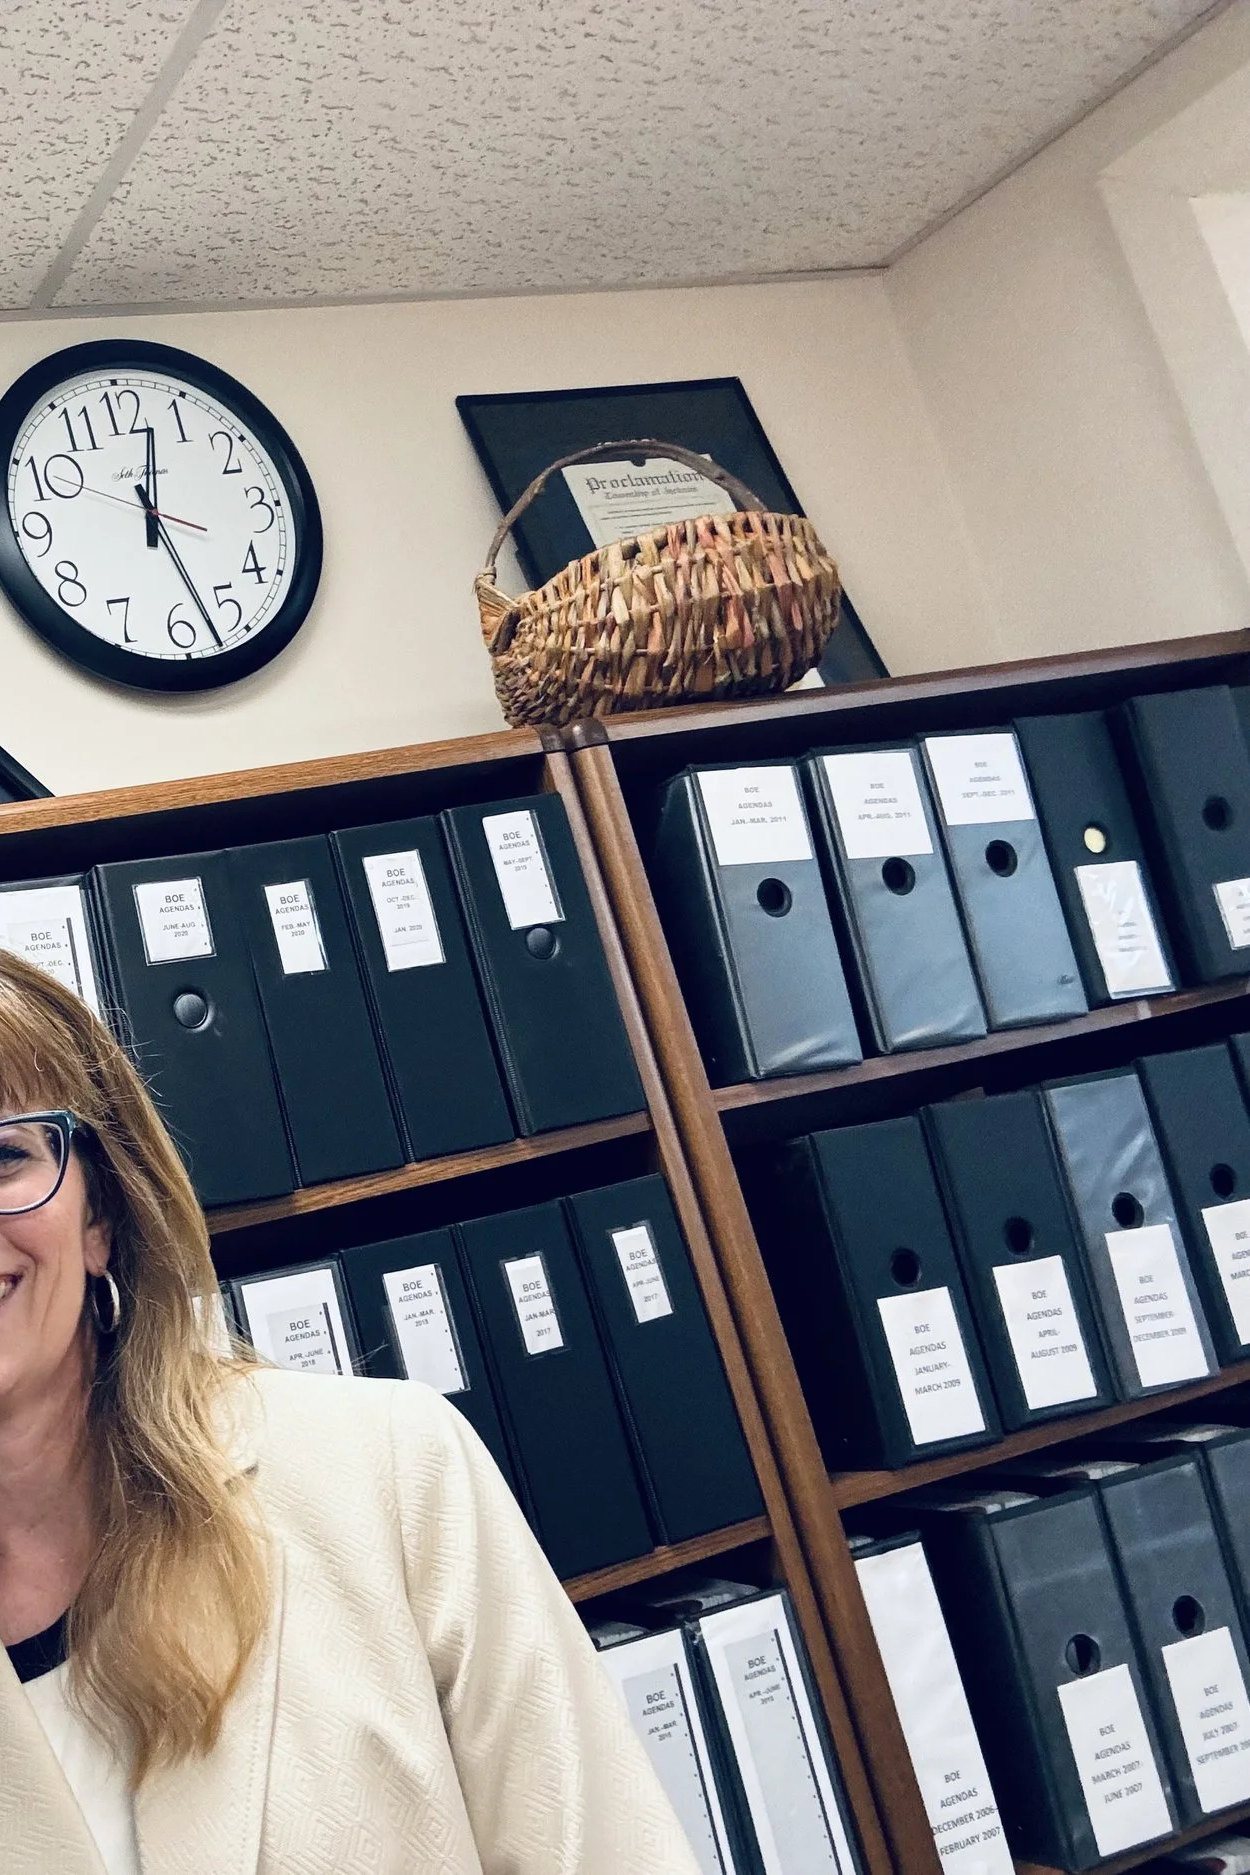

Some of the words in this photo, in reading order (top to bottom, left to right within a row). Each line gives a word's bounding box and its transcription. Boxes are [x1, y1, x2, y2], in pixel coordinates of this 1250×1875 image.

[99, 389, 150, 437] 12
[167, 398, 194, 443] 1
[58, 405, 104, 453] 11
[208, 431, 243, 475] 2
[24, 453, 85, 502] 10
[111, 467, 134, 482] Seth
[586, 471, 704, 494] Proclamation
[243, 486, 275, 533] 3
[21, 511, 53, 558] 9
[241, 539, 269, 585] 4
[54, 560, 87, 607] 8
[212, 582, 243, 632] 5
[106, 596, 138, 643] 7
[166, 603, 197, 649] 6
[738, 801, 773, 809] AGENDAS
[502, 830, 522, 841] BOE
[499, 840, 531, 851] AGENDAS
[386, 868, 406, 878] BOE
[381, 877, 415, 888] AGENDAS
[164, 893, 186, 904] BOE
[279, 894, 301, 905] BOE
[159, 904, 195, 914] AGENDAS
[275, 903, 309, 915] AGENDAS
[30, 931, 53, 942] BOE
[173, 930, 189, 938] 2020
[291, 929, 306, 938] 2020
[25, 942, 62, 952] AGENDAS
[629, 1249, 648, 1261] BOE
[626, 1257, 657, 1271] AGENDAS
[402, 1280, 423, 1292] BOE
[522, 1280, 542, 1292] BOE
[1139, 1274, 1154, 1284] BOE
[398, 1290, 433, 1303] AGENDAS
[519, 1290, 551, 1303] AGENDAS
[1031, 1290, 1047, 1300] BOE
[1133, 1292, 1168, 1304] AGENDAS
[1026, 1307, 1063, 1321] AGENDAS
[290, 1319, 311, 1331] BOE
[914, 1323, 931, 1334] BOE
[285, 1329, 321, 1343] AGENDAS
[536, 1328, 551, 1337] 2017
[1132, 1329, 1169, 1343] DECEMBER
[909, 1341, 947, 1356] AGENDAS
[1031, 1346, 1059, 1359] AUGUST
[1060, 1343, 1078, 1354] 2009
[914, 1383, 943, 1396] MARCH
[943, 1378, 961, 1389] 2009
[748, 1655, 766, 1669] BOE
[744, 1664, 776, 1681] AGENDAS
[646, 1690, 666, 1704] BOE
[1203, 1684, 1219, 1697] BOE
[642, 1700, 675, 1716] AGENDAS
[1198, 1701, 1234, 1720] AGENDAS
[1099, 1724, 1115, 1737] BOE
[1094, 1741, 1132, 1761] AGENDAS
[1196, 1744, 1239, 1765] SEPTEMBER
[944, 1770, 962, 1784] BOE
[1091, 1768, 1122, 1785] MARCH
[940, 1788, 979, 1809] AGENDAS
[1104, 1789, 1124, 1804] JUNE
[1124, 1782, 1143, 1796] 2007
[932, 1813, 976, 1836] DECEMBER
[940, 1834, 981, 1857] FEBRUARY
[982, 1826, 1001, 1841] 2007
